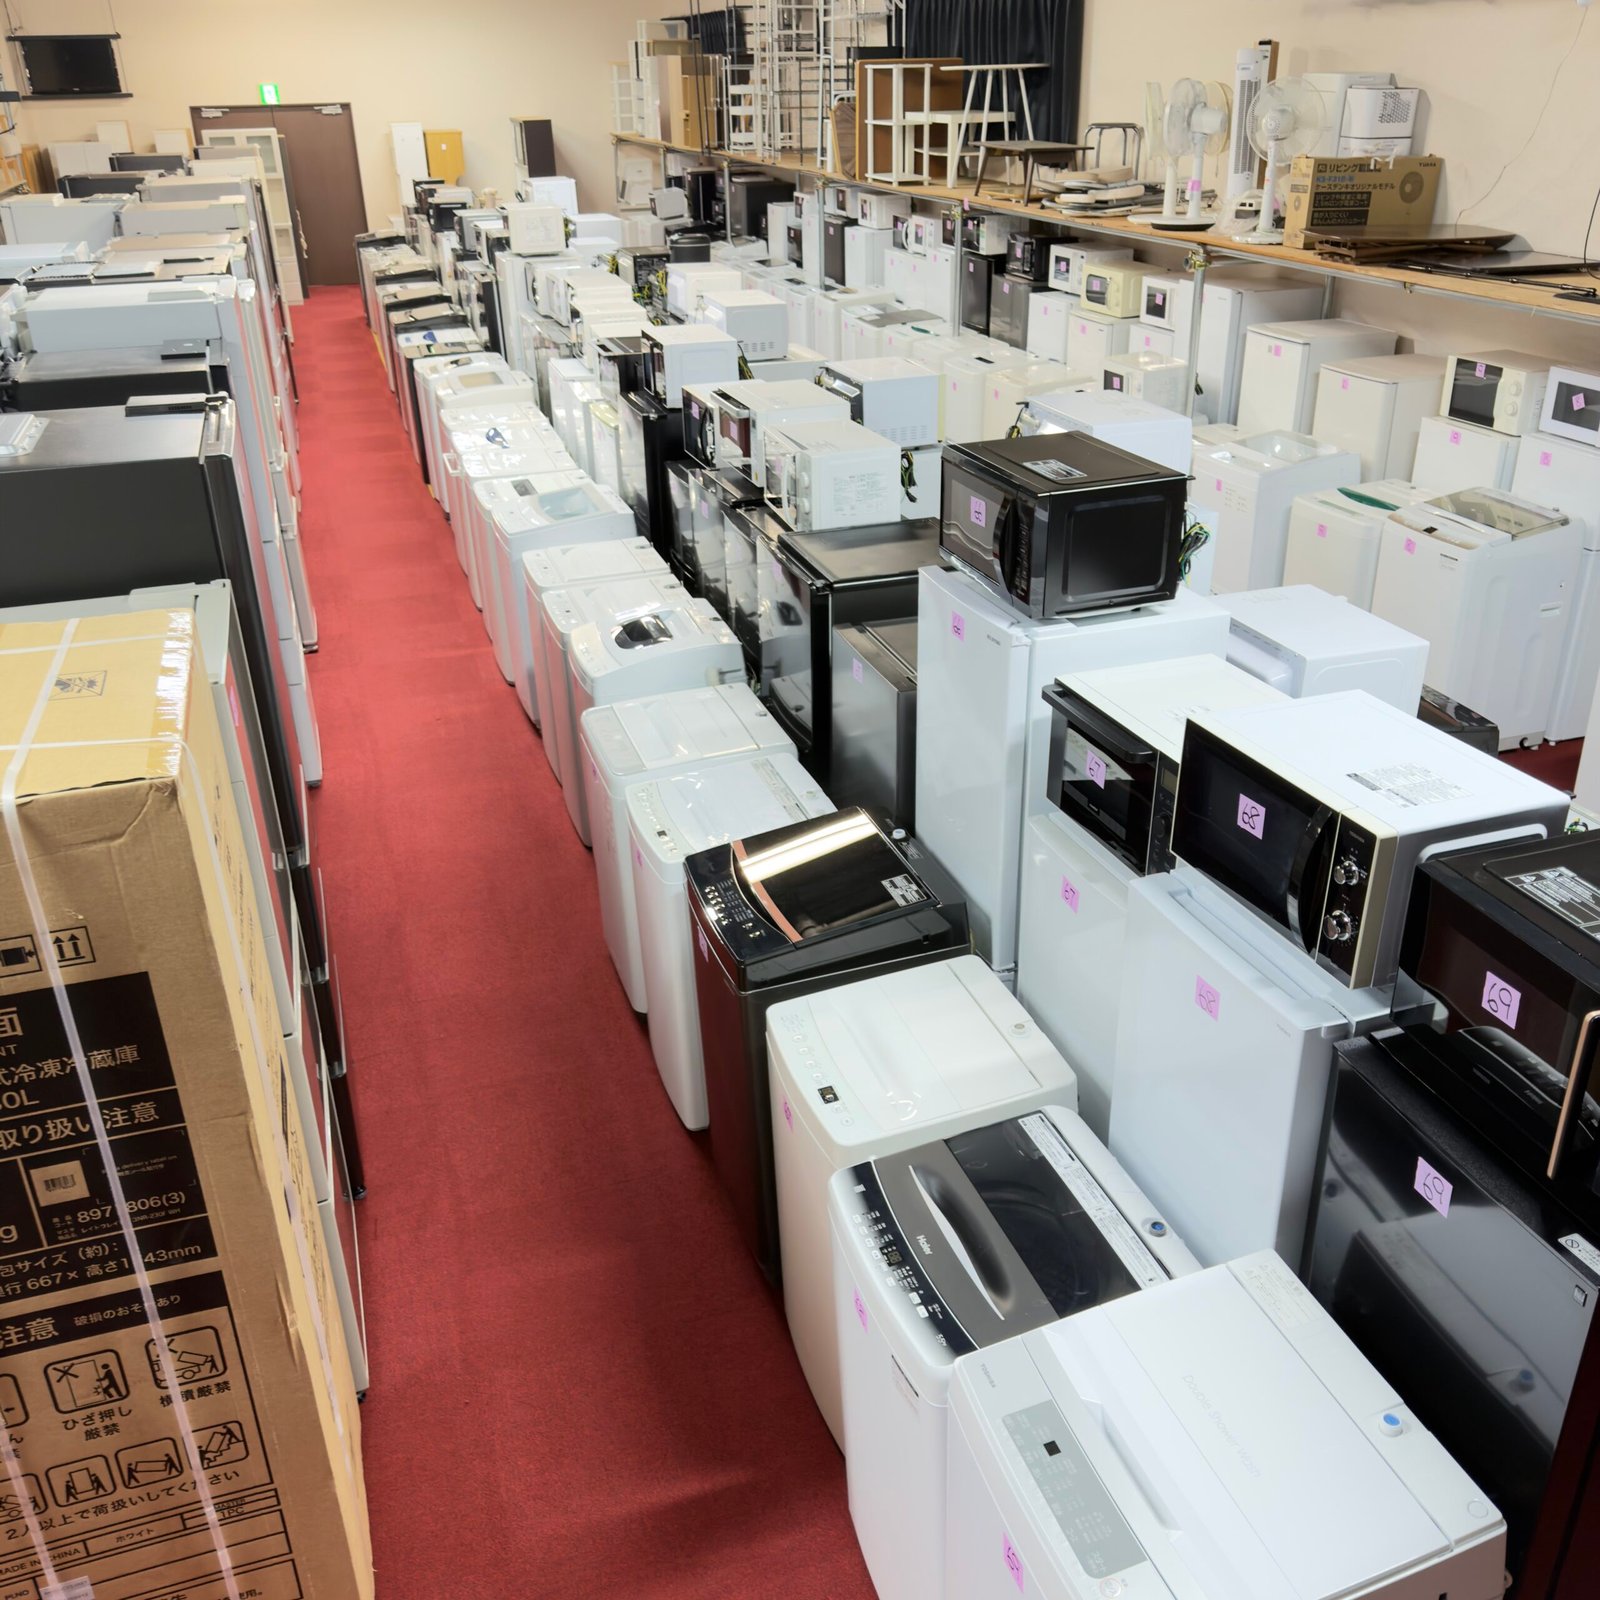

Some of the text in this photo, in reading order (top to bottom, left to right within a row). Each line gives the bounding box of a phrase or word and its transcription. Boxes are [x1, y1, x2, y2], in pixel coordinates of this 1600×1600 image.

[1242, 803, 1260, 830] 68
[1487, 982, 1512, 1020] 69
[1422, 1172, 1444, 1205] 69
[73, 1294, 181, 1327] 破損のおそあり
[62, 1405, 133, 1431] ひざ押し
[84, 1422, 121, 1442] 厳禁
